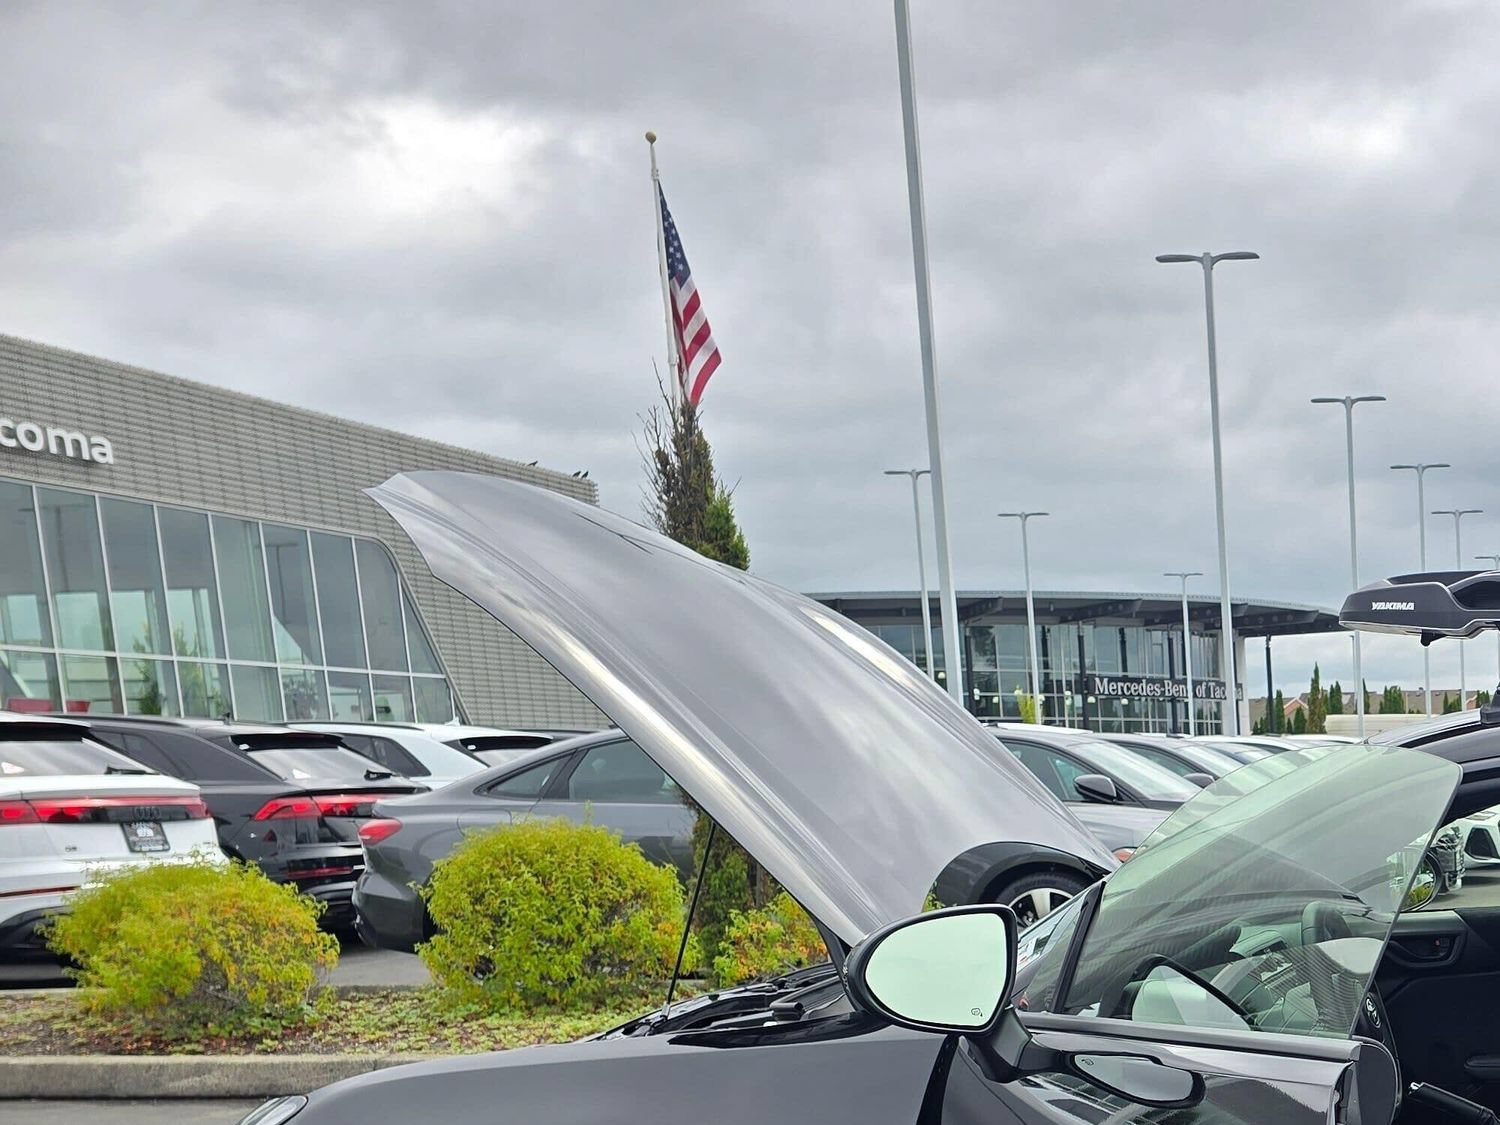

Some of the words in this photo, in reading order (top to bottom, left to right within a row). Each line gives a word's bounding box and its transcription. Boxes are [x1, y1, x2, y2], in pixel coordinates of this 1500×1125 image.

[0, 418, 114, 465] coma
[1371, 601, 1415, 611] YAKIMA
[1094, 677, 1193, 698] Mercedes-Ben
[1196, 681, 1207, 699] of
[1207, 682, 1243, 700] Taca
